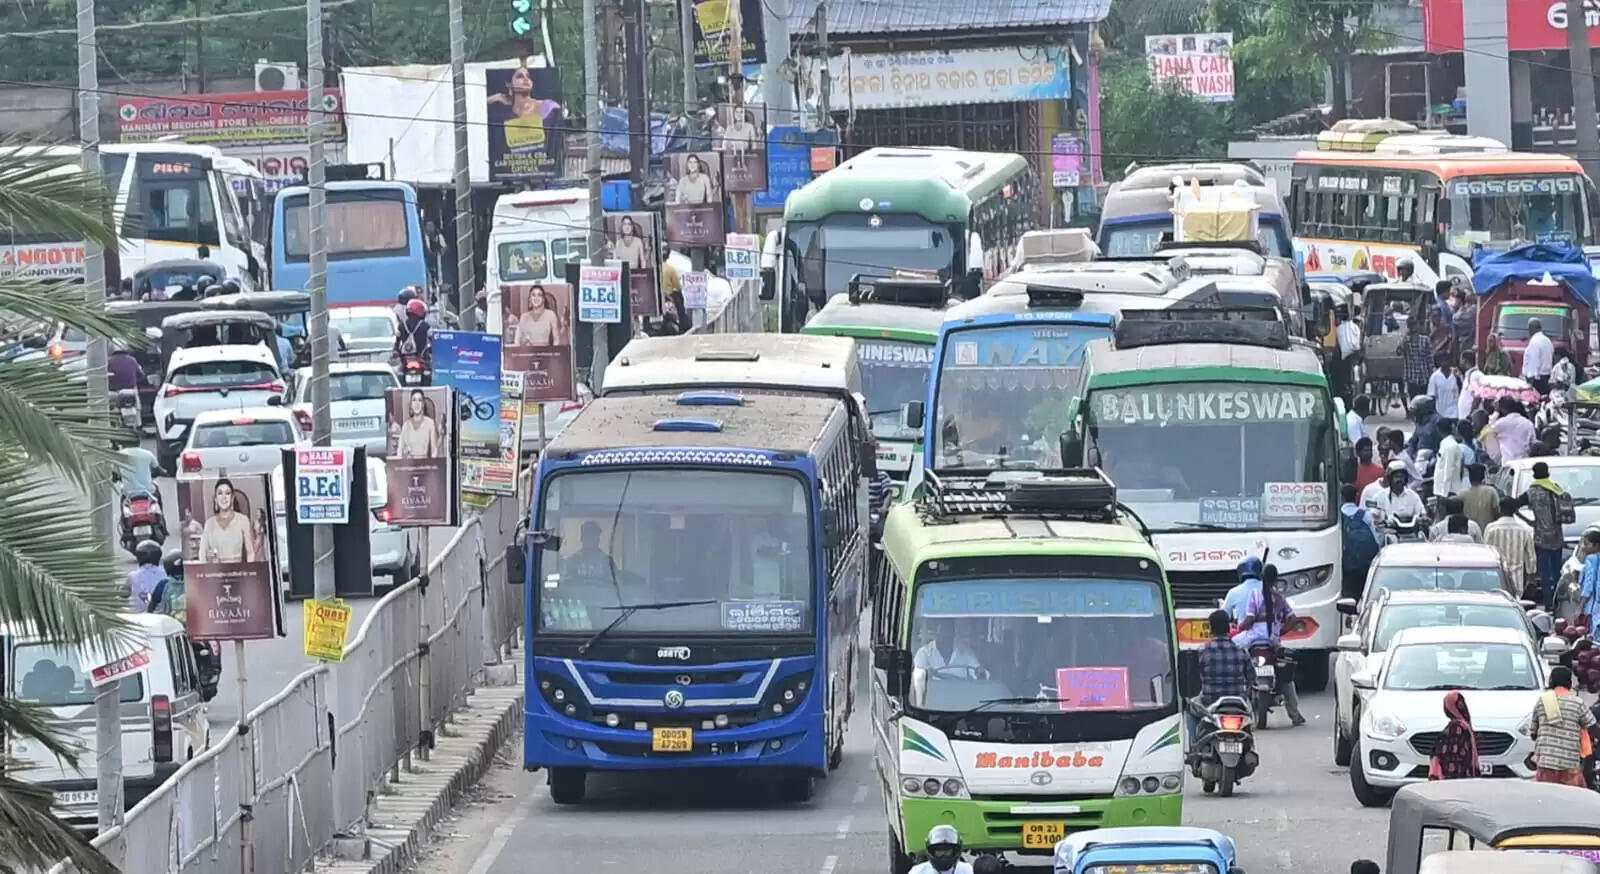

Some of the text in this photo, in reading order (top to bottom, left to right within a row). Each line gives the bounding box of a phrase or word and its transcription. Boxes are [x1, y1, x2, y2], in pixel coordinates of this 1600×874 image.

[1199, 55, 1229, 73] CAR
[1197, 75, 1233, 93] WASH
[582, 287, 616, 303] B.Ed
[1103, 391, 1315, 421] BALUNKESWAR
[299, 475, 341, 497] B.Ed
[975, 750, 1104, 768] Manibaba
[1030, 824, 1043, 833] OR
[1026, 835, 1033, 844] E
